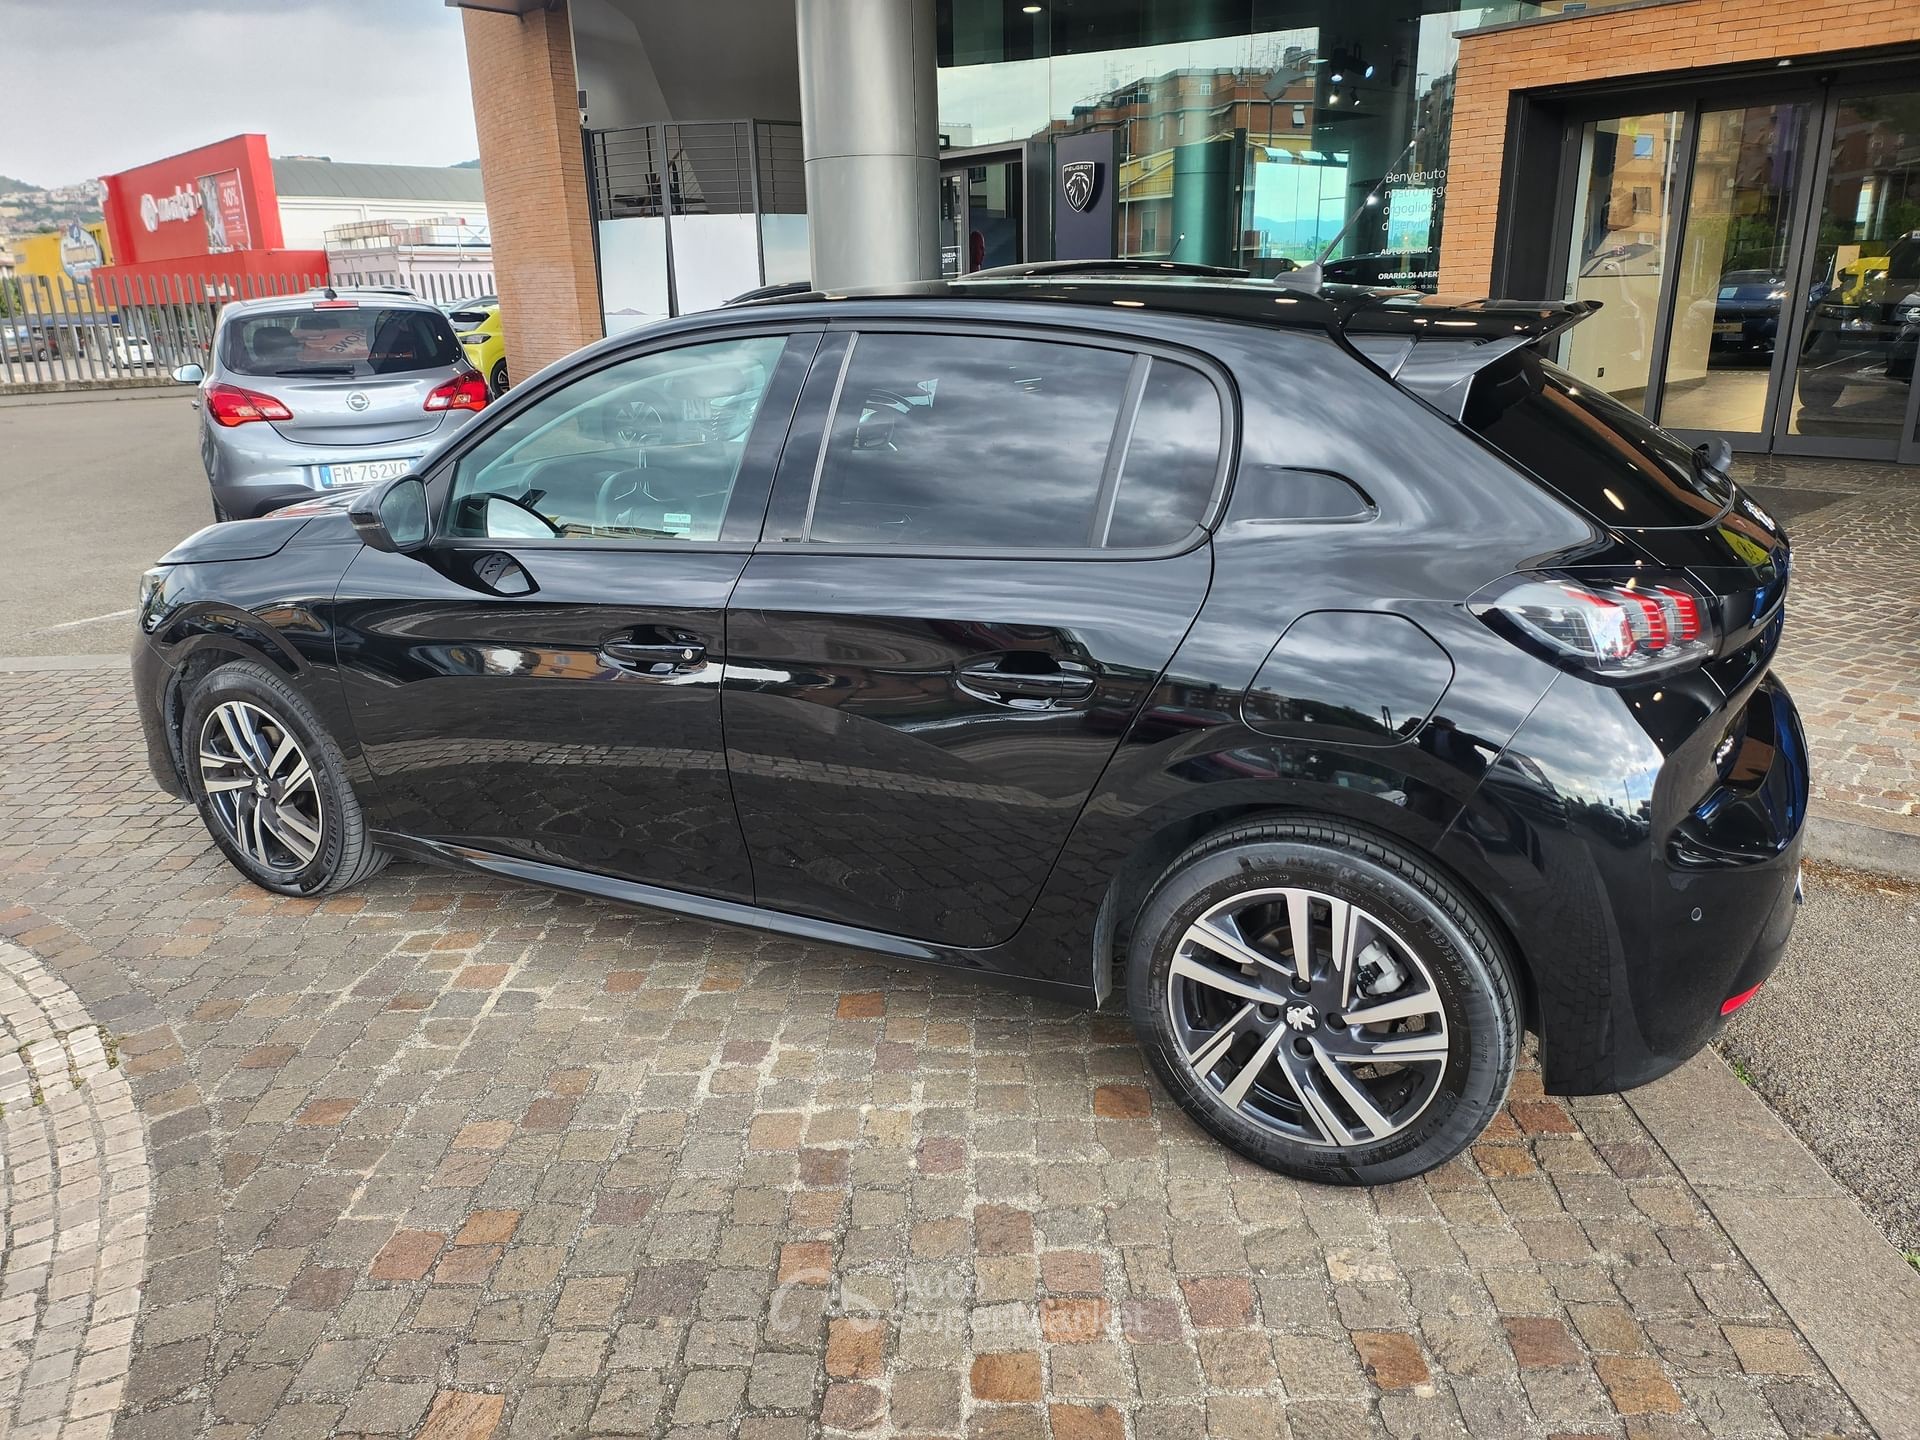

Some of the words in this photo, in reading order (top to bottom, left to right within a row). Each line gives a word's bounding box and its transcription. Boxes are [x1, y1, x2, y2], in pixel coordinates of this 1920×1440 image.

[1064, 164, 1092, 172] PEUGEOT
[1385, 168, 1446, 184] Benvenuto
[1382, 200, 1437, 217] orgogliosi
[1378, 272, 1407, 280] ORARIO
